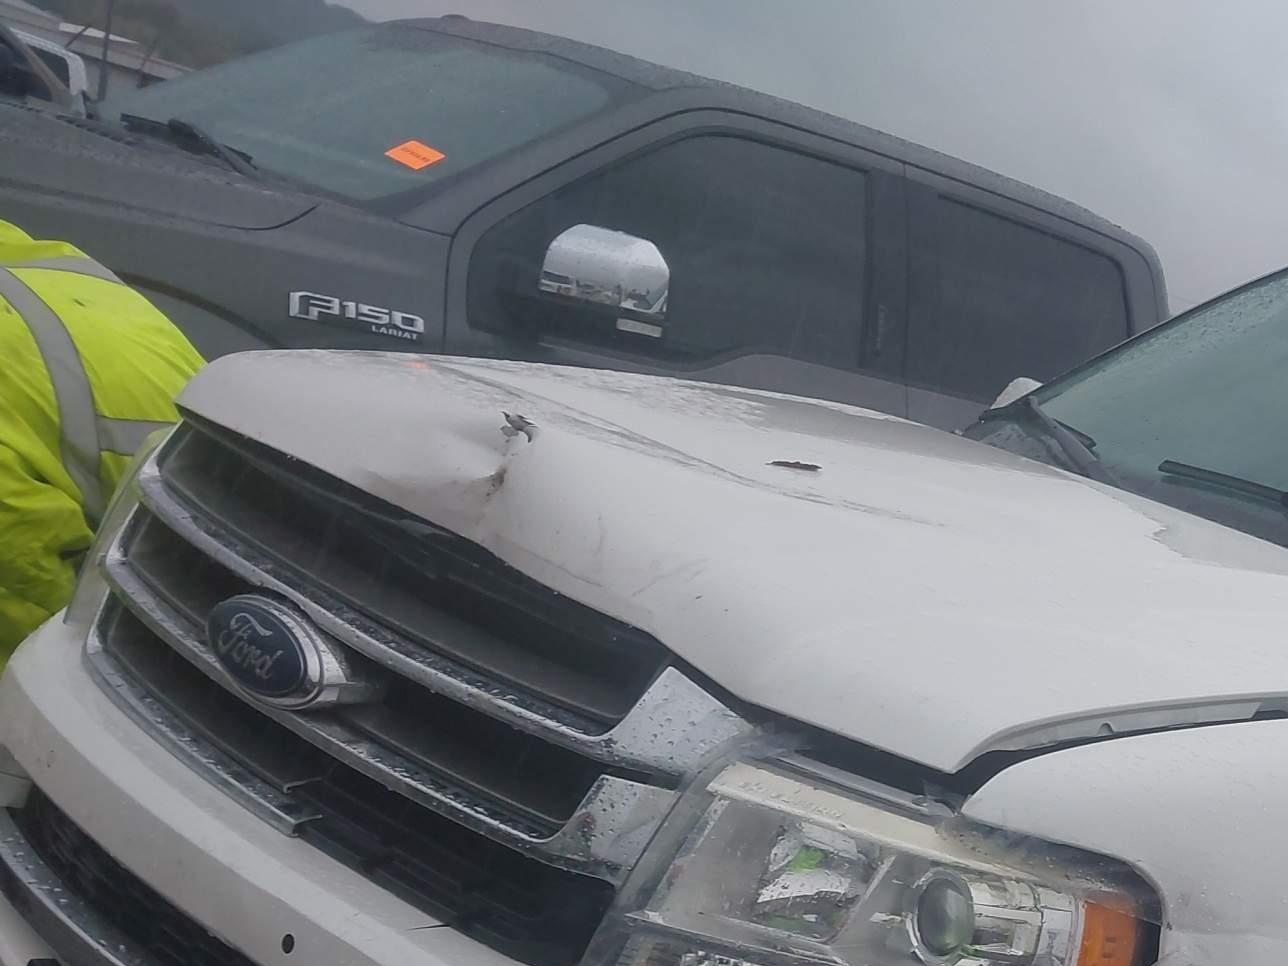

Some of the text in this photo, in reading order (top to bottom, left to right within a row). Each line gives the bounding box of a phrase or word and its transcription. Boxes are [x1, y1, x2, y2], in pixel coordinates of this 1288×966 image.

[289, 291, 424, 333] F150
[371, 325, 418, 341] LARIAT
[218, 612, 284, 679] Ford
